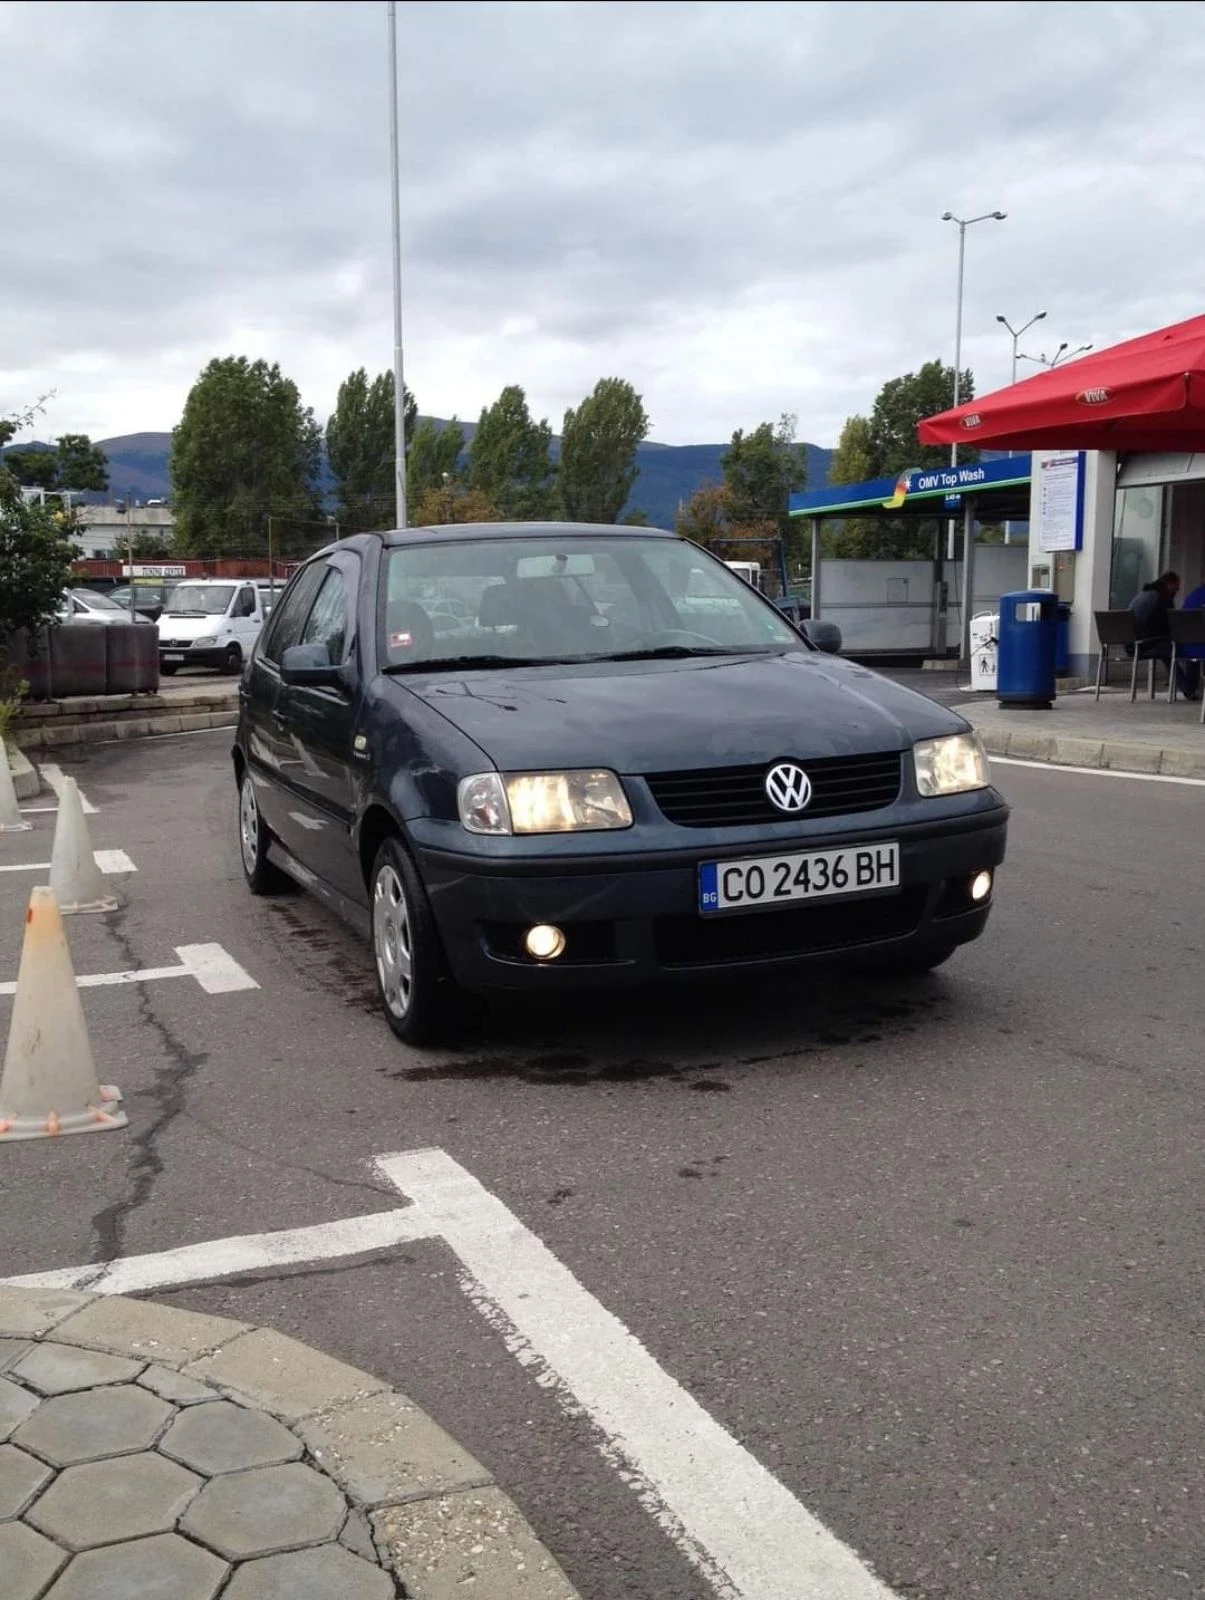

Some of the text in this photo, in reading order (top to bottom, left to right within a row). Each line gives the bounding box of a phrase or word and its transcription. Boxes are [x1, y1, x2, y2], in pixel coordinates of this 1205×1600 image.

[1084, 390, 1108, 403] VIVA
[918, 468, 985, 489] OMV Top Wash
[773, 855, 848, 897] 2436
[856, 848, 895, 886] BH
[703, 892, 717, 904] BG
